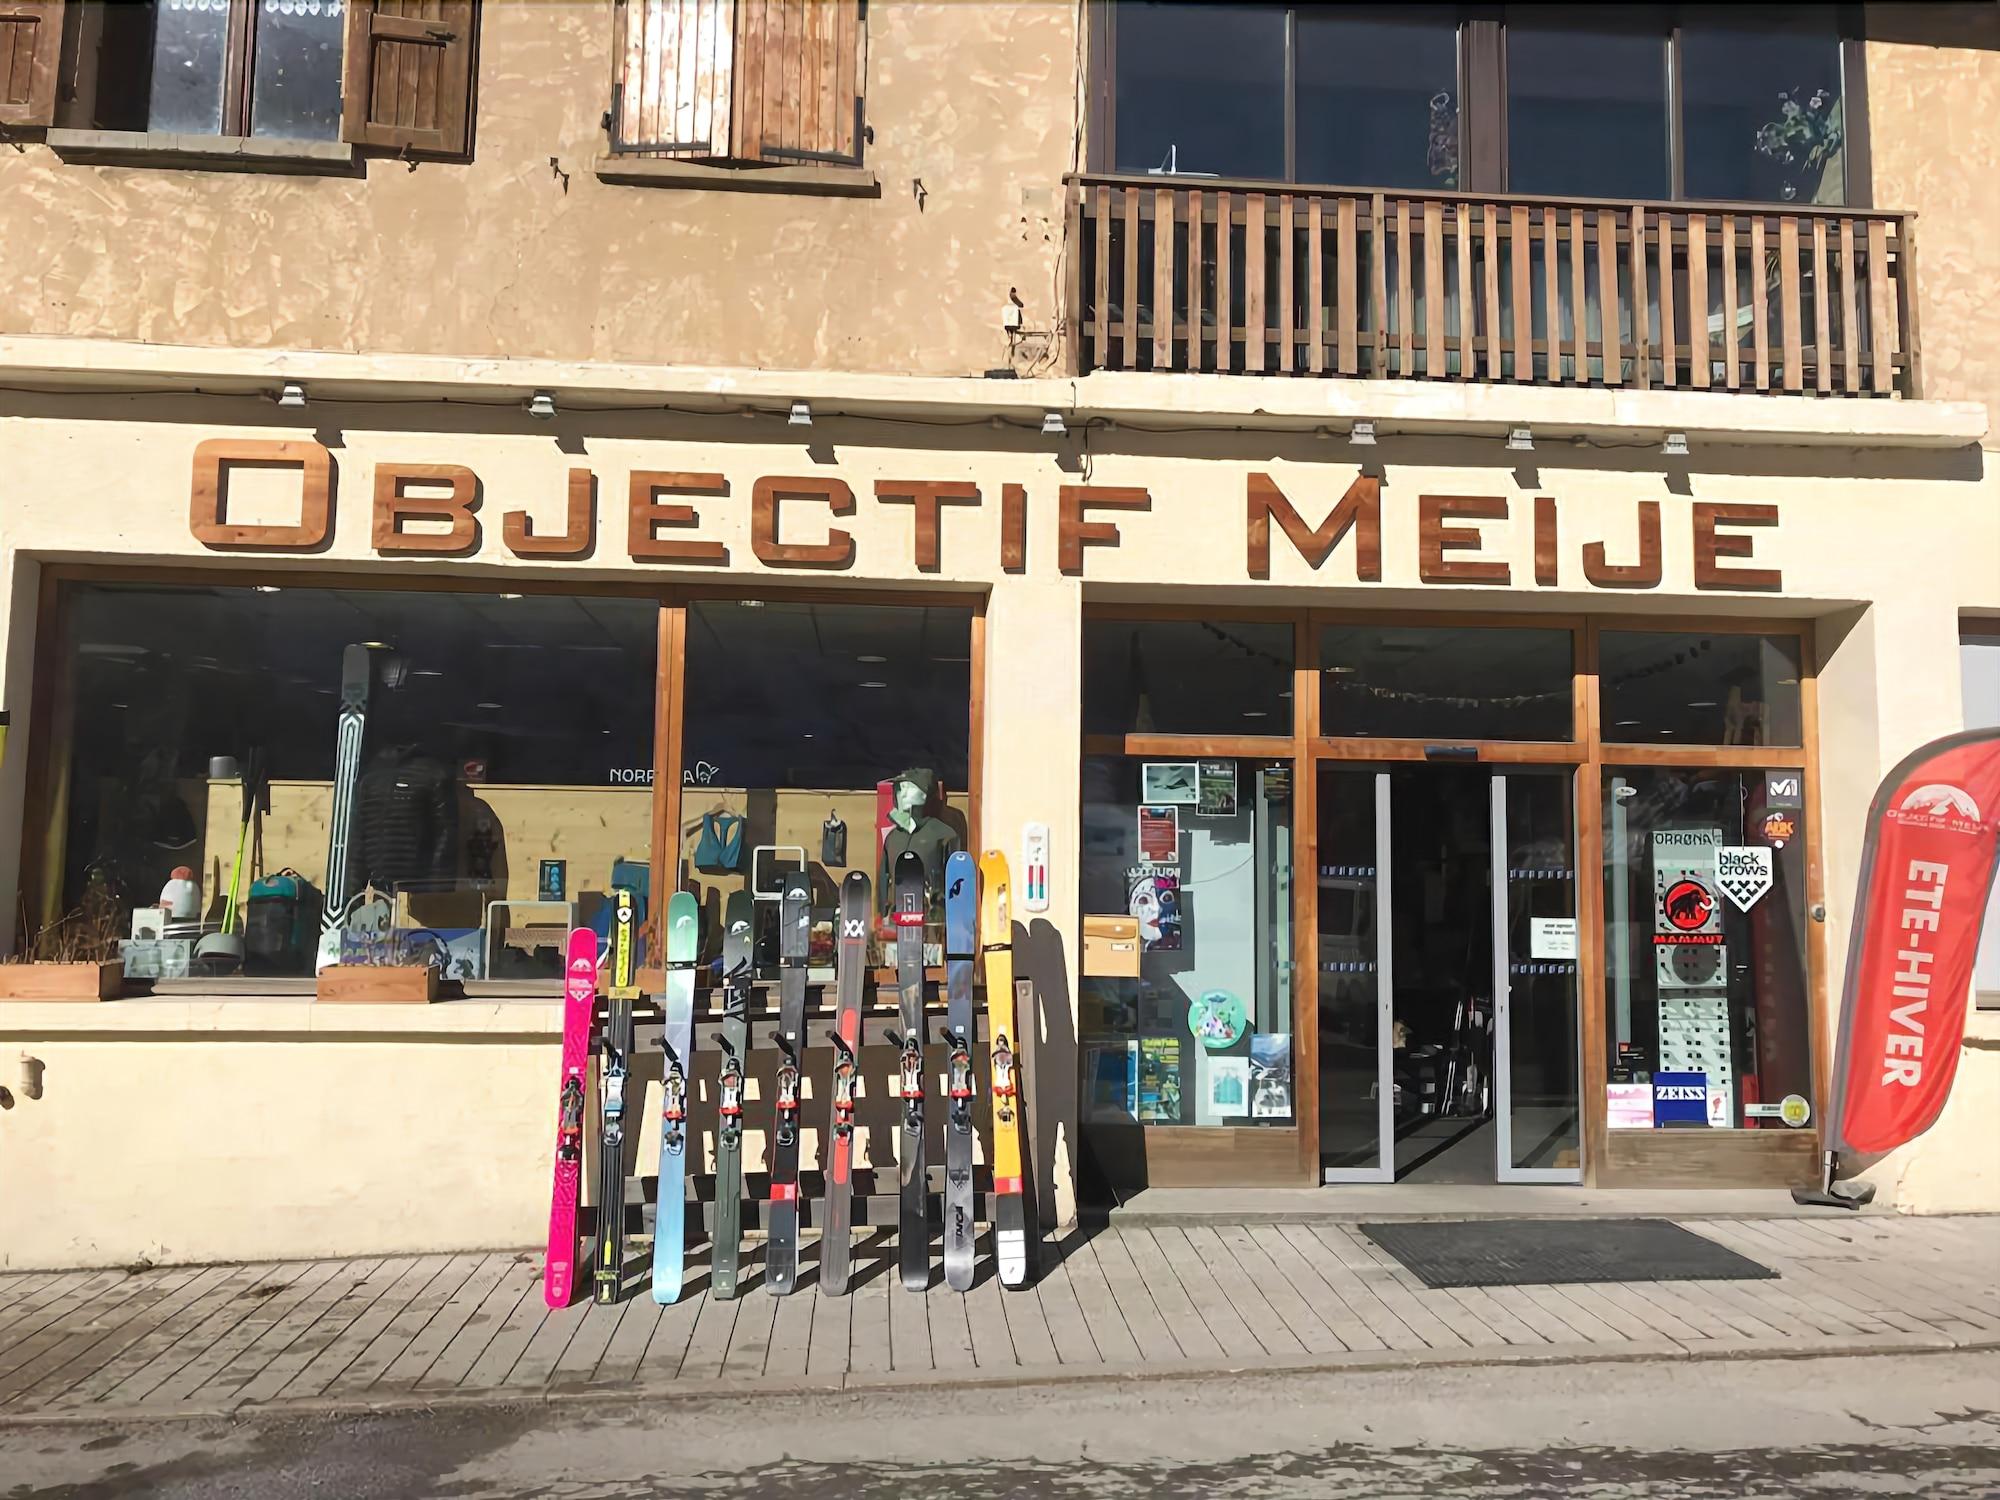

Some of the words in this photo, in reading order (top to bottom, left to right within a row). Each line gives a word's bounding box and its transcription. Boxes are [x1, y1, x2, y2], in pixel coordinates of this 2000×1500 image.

[189, 438, 1150, 574] OBJECTIF
[1247, 472, 1782, 592] MEIJE
[1719, 852, 1760, 866] black
[1719, 865, 1768, 876] crows
[1653, 935, 1724, 944] MAMMUT
[1881, 858, 1950, 1088] ETE-HIVER
[1656, 1086, 1706, 1101] ZEISS
